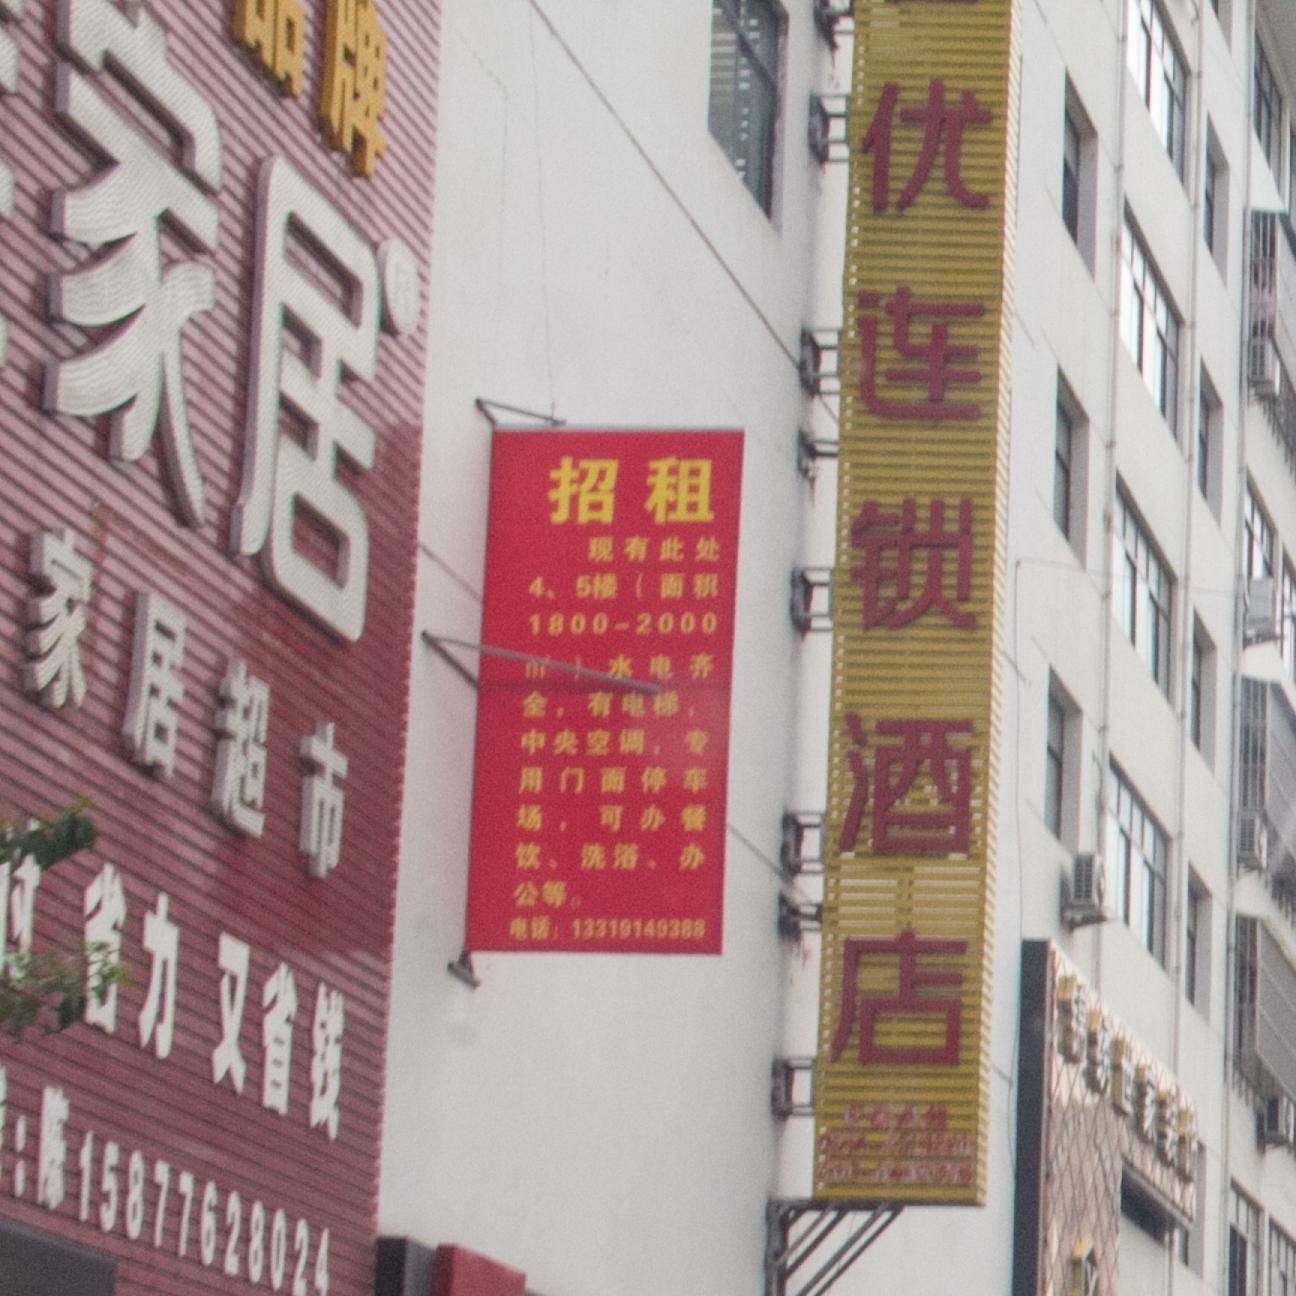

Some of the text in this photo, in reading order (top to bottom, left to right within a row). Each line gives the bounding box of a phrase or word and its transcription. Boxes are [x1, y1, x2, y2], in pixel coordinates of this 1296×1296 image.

[547, 455, 715, 525] 招租
[587, 536, 721, 563] 现有此处
[527, 612, 718, 637] 1800-2000
[28, 526, 350, 879] 家居超市
